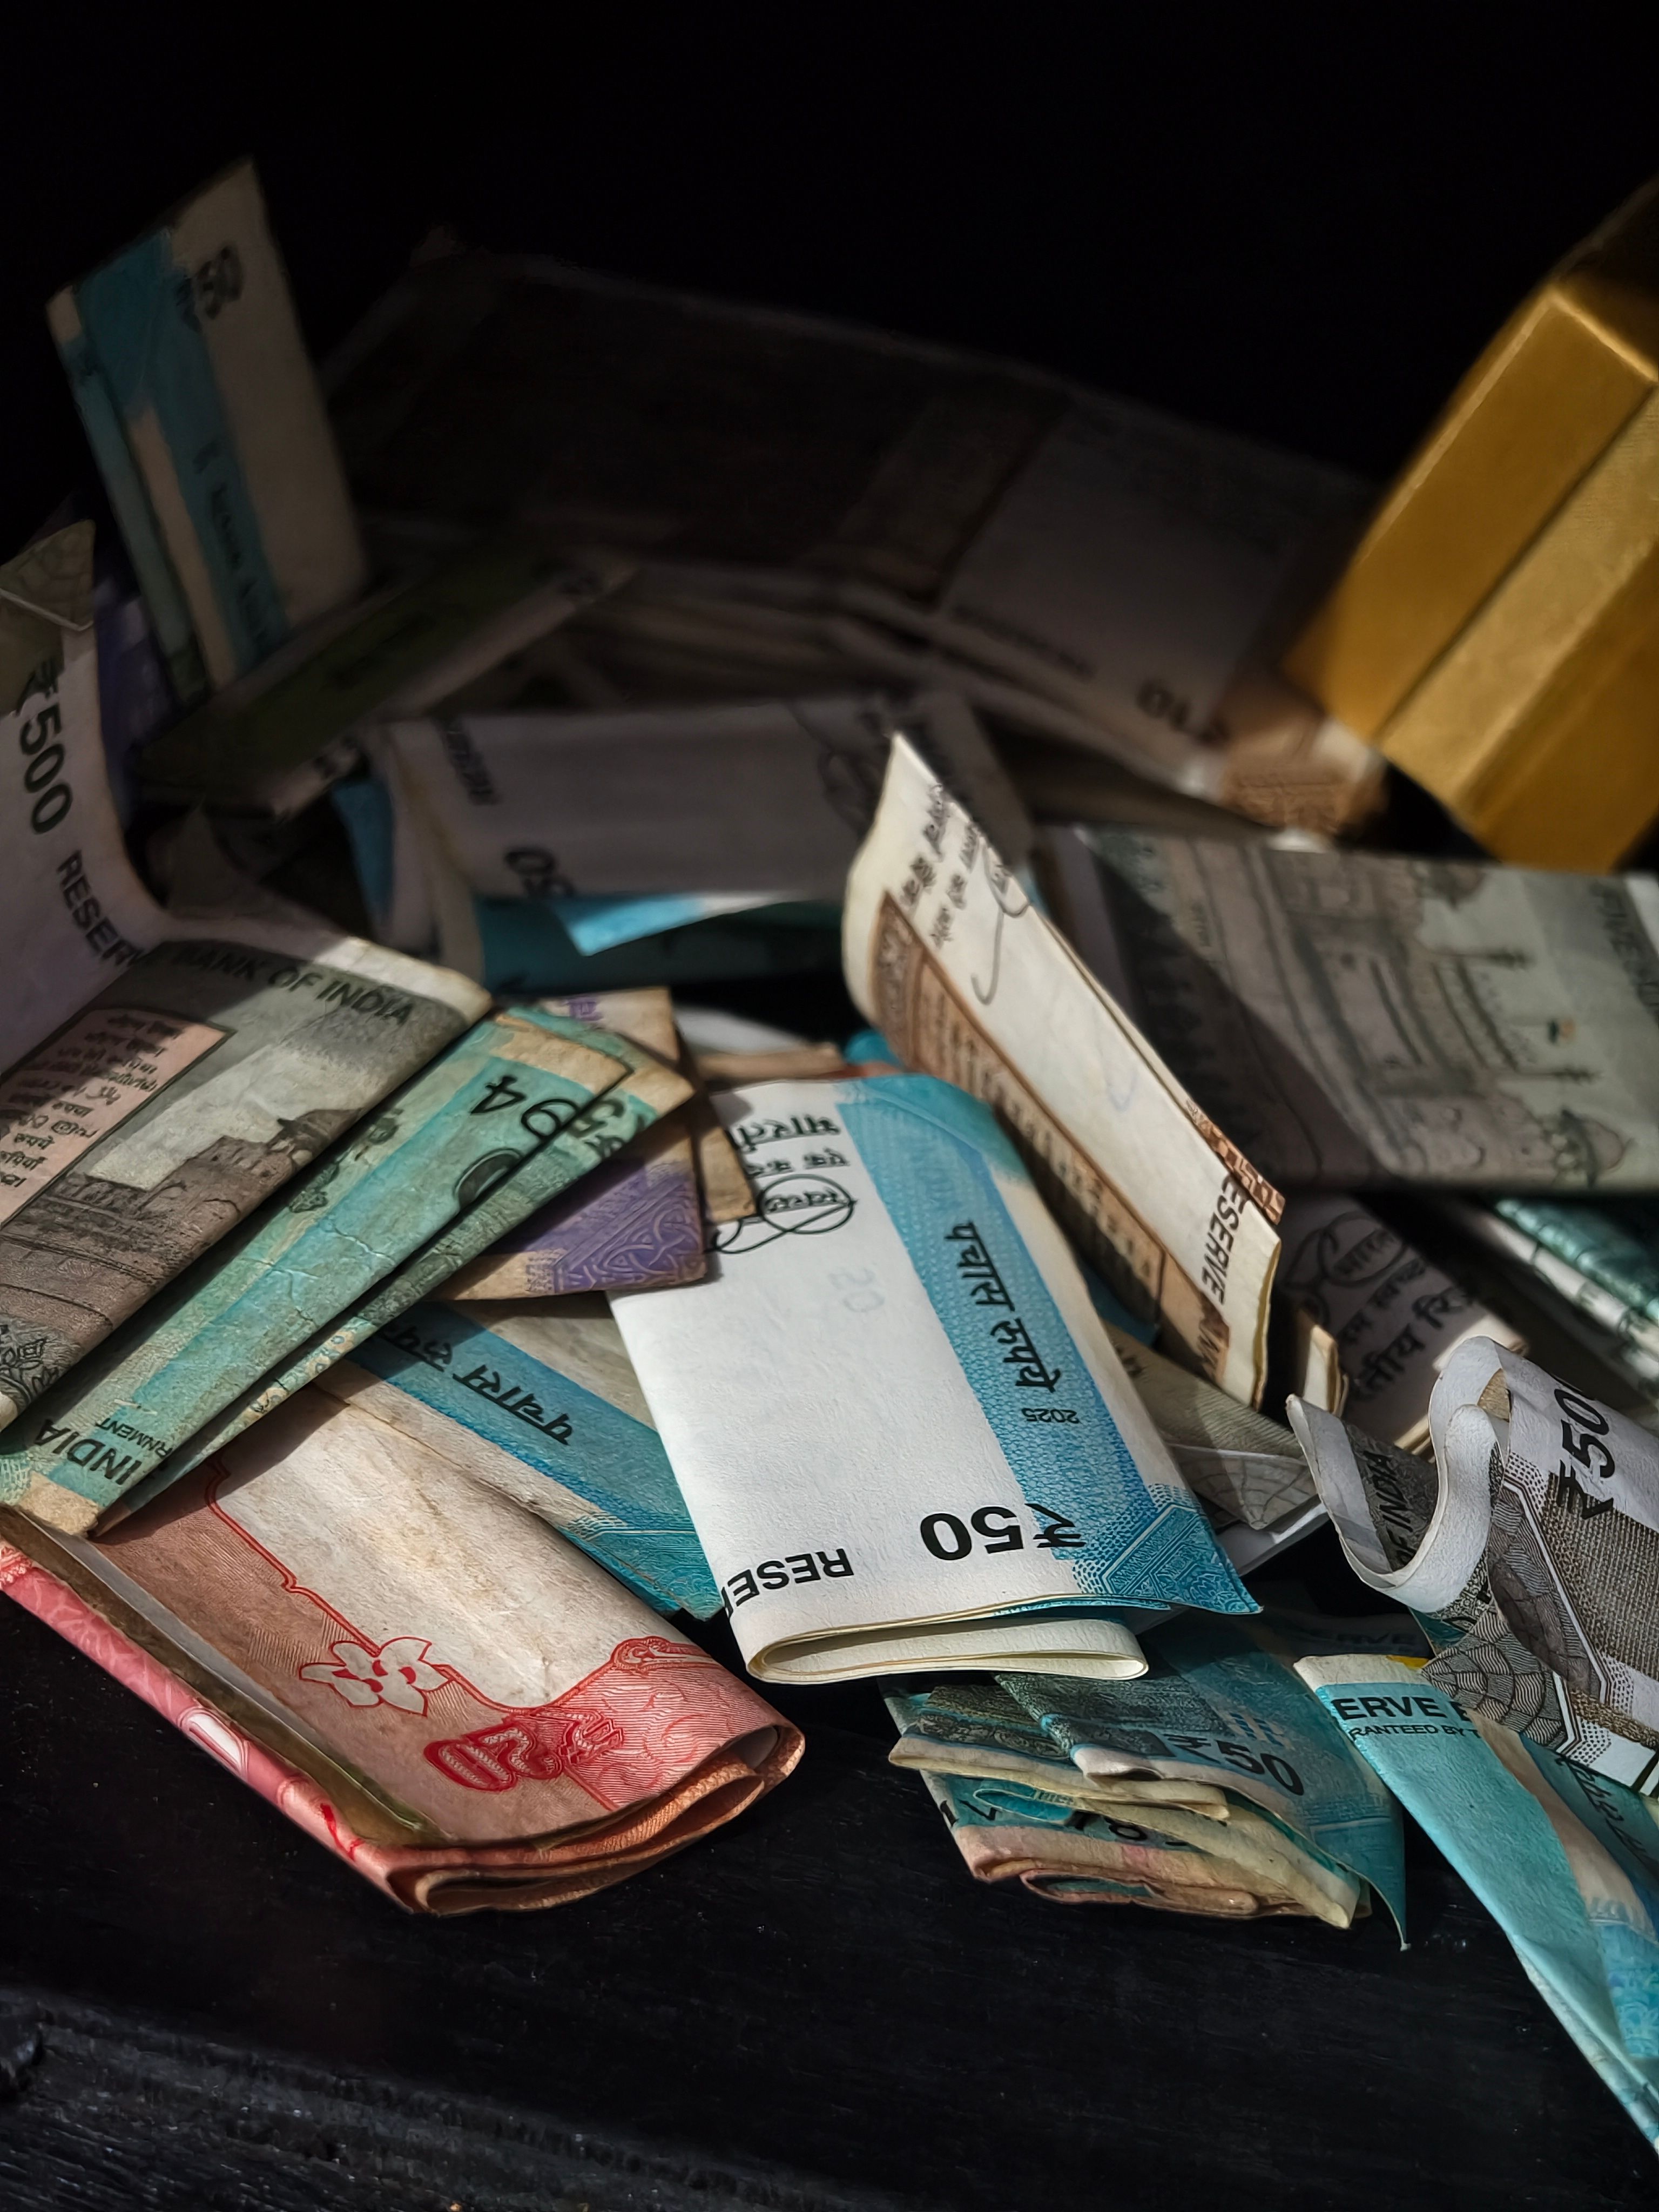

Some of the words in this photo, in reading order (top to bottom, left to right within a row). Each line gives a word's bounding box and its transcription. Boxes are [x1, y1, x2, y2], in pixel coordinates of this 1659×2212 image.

[16, 657, 72, 835] ₹500
[268, 969, 324, 994] OF
[314, 976, 415, 1025] INDIA
[944, 1219, 1015, 1312] पचास
[990, 1317, 1061, 1393] रुपये
[451, 1364, 574, 1446] पचास
[1021, 1408, 1080, 1424] 2025
[34, 1418, 142, 1486] INDIA
[96, 1417, 176, 1458] RNMENT
[1554, 1388, 1615, 1520] ₹50
[920, 1502, 1087, 1561] ₹50
[1331, 1696, 1448, 1721] ERVE
[1347, 1724, 1439, 1743] RANTEED
[1441, 1724, 1466, 1738] BY
[1163, 1732, 1305, 1796] ₹50
